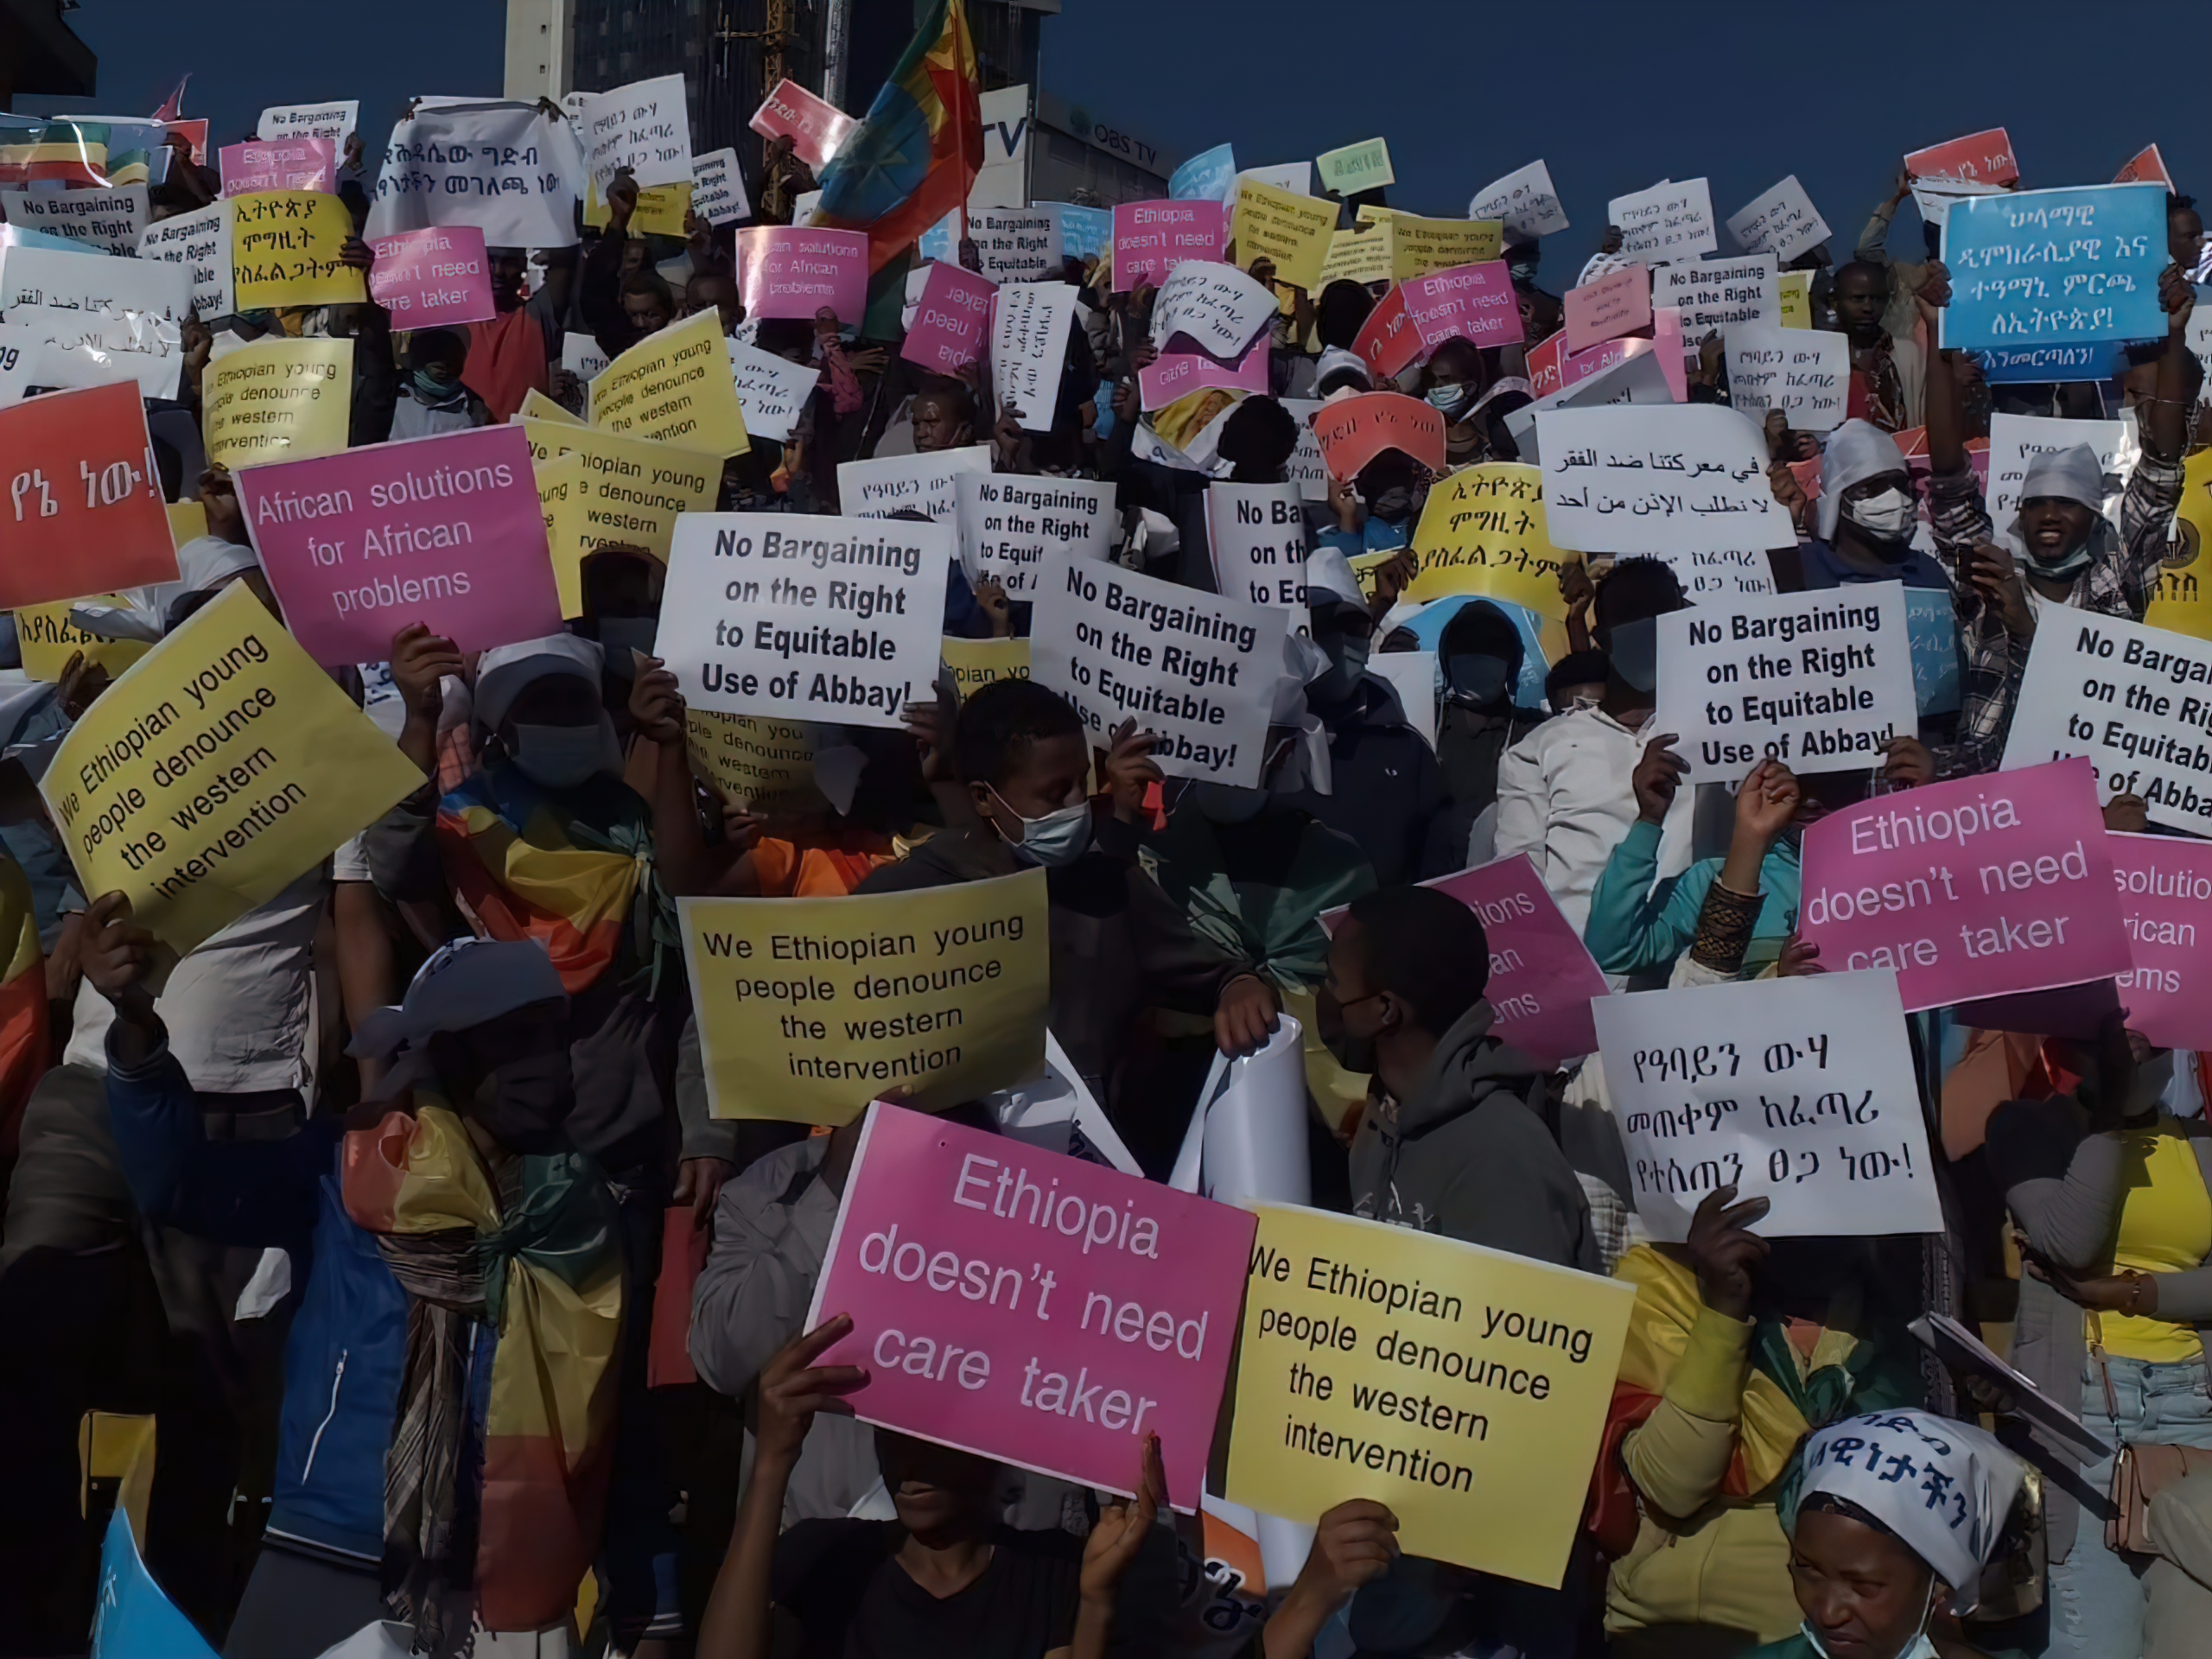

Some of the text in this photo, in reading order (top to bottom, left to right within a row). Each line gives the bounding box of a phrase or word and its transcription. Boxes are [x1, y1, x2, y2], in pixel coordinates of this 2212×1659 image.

[22, 200, 45, 215] No
[1175, 230, 1215, 246] need
[194, 289, 223, 312] bbay!
[652, 467, 706, 493] young
[1554, 449, 1598, 474] الفقر
[1606, 454, 1643, 469] ضد
[1731, 455, 1760, 484] في
[10, 446, 156, 522] የኔ ነው!
[258, 462, 514, 525] African solutions
[599, 481, 686, 512] denounce
[979, 484, 1098, 515] No Bargaining
[1556, 487, 1590, 509] أحد
[588, 510, 658, 533] western
[984, 514, 1090, 542] on the Right
[1236, 500, 1262, 524] No
[308, 521, 473, 567] for African
[715, 529, 921, 576] No Bargaining
[981, 541, 994, 558] to
[1249, 545, 1275, 564] on
[332, 571, 472, 620] problems
[725, 577, 906, 619] on the Right
[1007, 571, 1027, 589] of
[1249, 581, 1269, 603] to
[1066, 567, 1256, 653] No Bargaining
[1689, 604, 1881, 646] No Bargaining
[715, 620, 897, 661] to Equitable
[1076, 621, 1239, 687] on the Right
[2076, 626, 2114, 658] No
[1706, 643, 1877, 684] on the Right
[702, 664, 912, 715] Use of Abbay!
[1070, 656, 1225, 725] to Equitable
[1706, 685, 1874, 726] to Equitable
[2083, 679, 2171, 716] on the
[57, 632, 270, 829] We Ethiopian young
[2069, 714, 2094, 741] to
[1701, 741, 1755, 766] Use
[1764, 733, 1790, 760] of
[82, 685, 277, 862] people denounce
[2109, 771, 2140, 795] of
[120, 744, 278, 871] the western
[1850, 793, 2021, 855] Ethiopia
[150, 781, 308, 900] intervention
[1808, 840, 2088, 925] doesn't need
[702, 915, 1024, 966] We Ethiopian young
[1847, 915, 2070, 973] care taker
[734, 958, 1002, 1006] people denounce
[780, 1007, 963, 1040] the western
[788, 1046, 963, 1080] intervention
[1764, 1033, 1828, 1073] ውሃ
[1627, 1089, 1879, 1138] መጠቀም ከፈጣሪ
[1839, 1142, 1914, 1182] ነው!
[953, 1152, 1160, 1260] Ethiopia
[858, 1223, 1209, 1362] doesn't need
[1249, 1244, 1593, 1363] We Ethiopian young
[1258, 1307, 1551, 1401] people denounce
[873, 1327, 1158, 1436] care taker
[1290, 1362, 1490, 1440] the western
[1285, 1414, 1473, 1493] intervention
